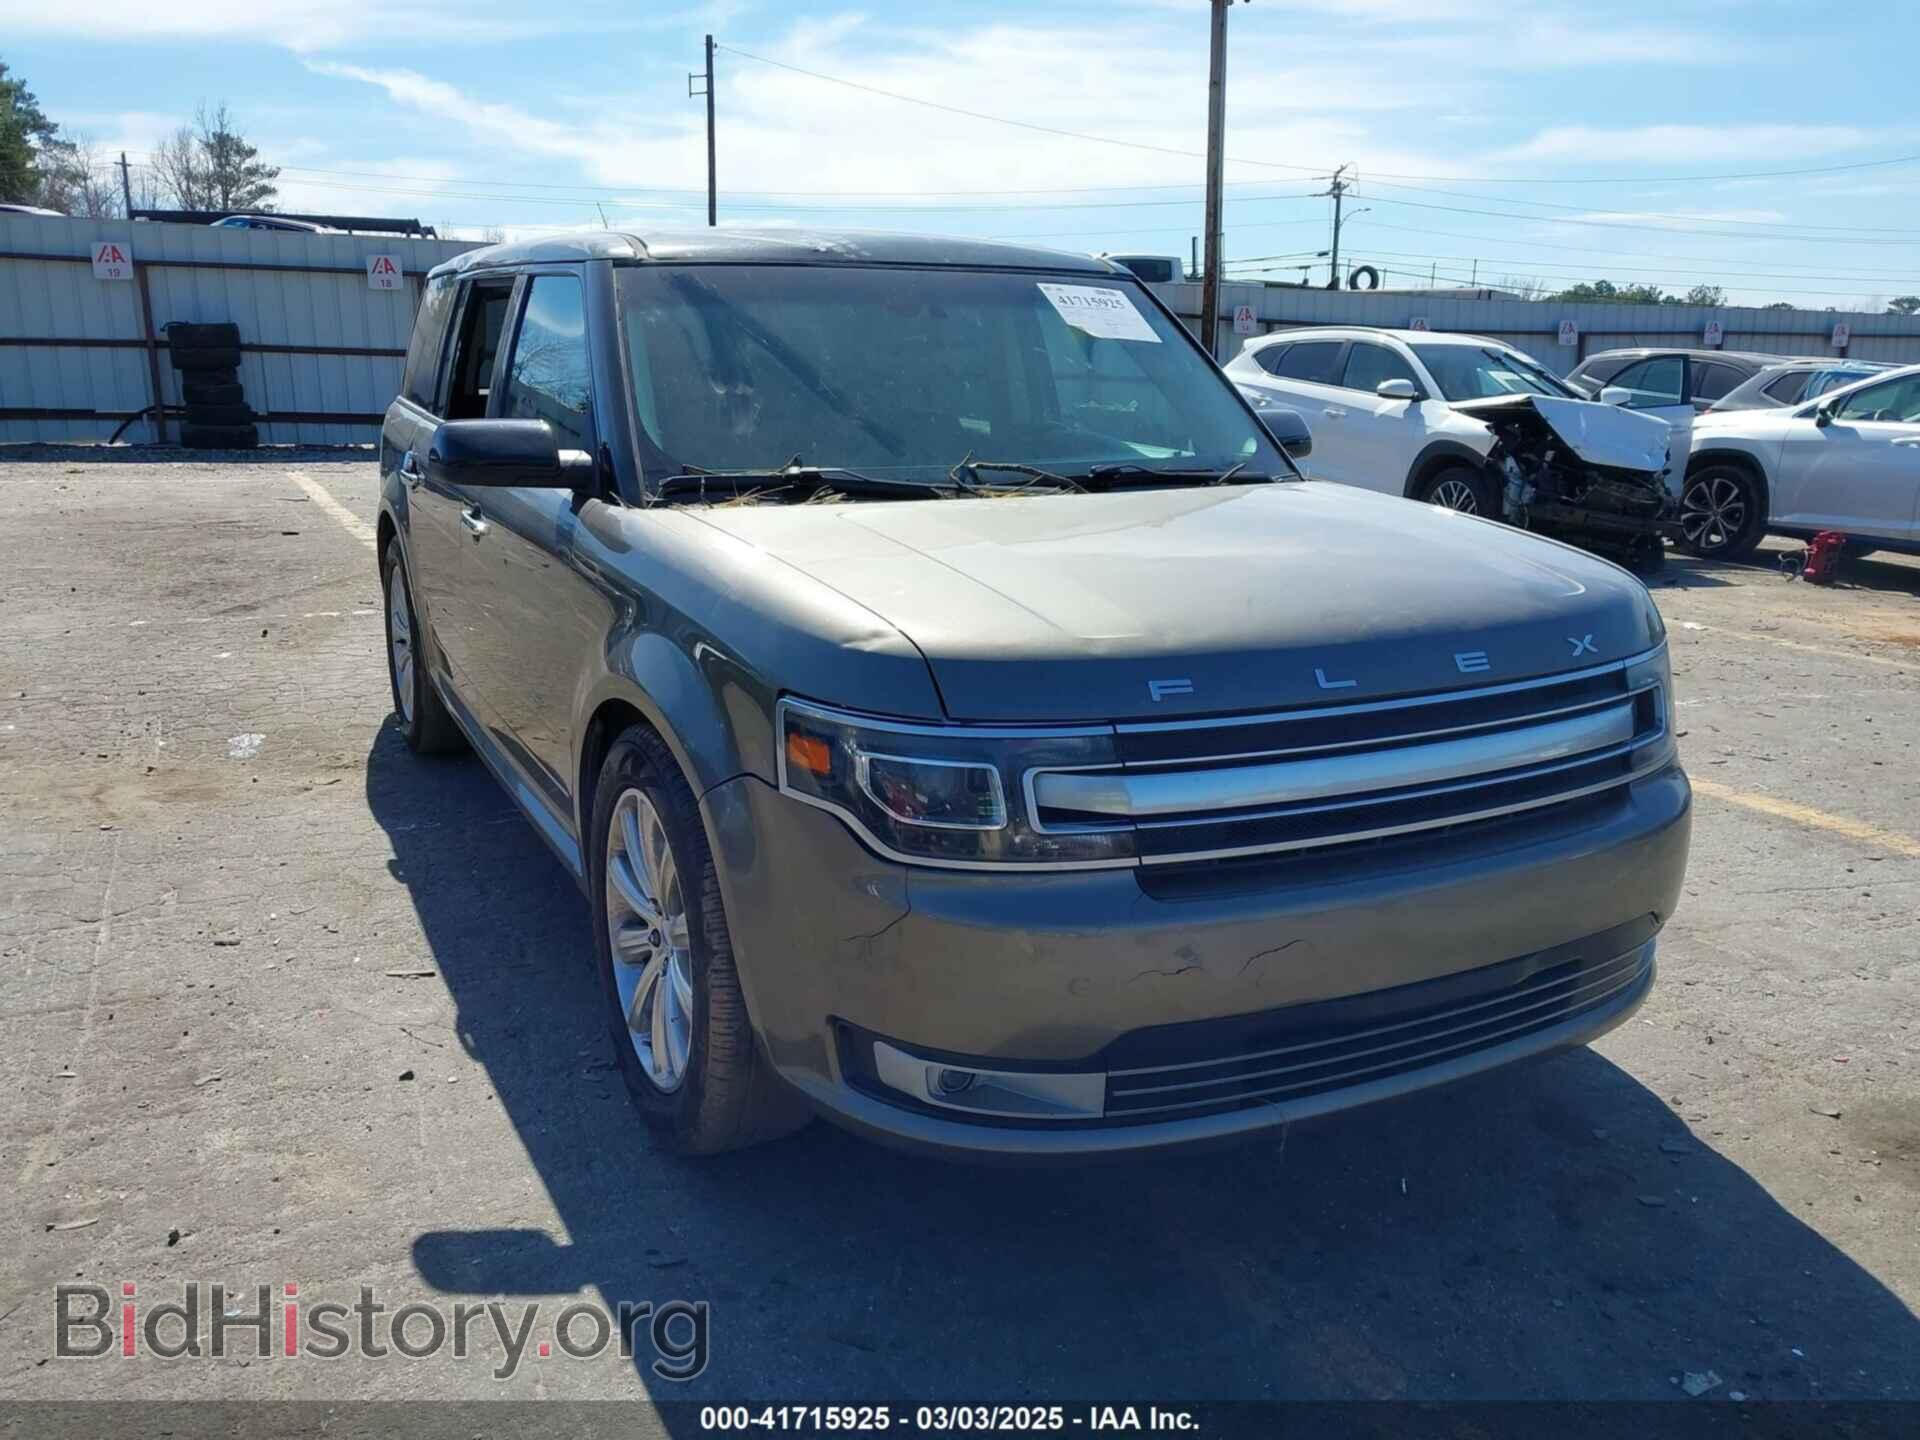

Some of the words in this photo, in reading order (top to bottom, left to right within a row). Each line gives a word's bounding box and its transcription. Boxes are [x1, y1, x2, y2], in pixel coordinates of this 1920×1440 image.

[107, 268, 121, 278] 19
[380, 279, 393, 288] 18
[1058, 295, 1126, 309] 41715925
